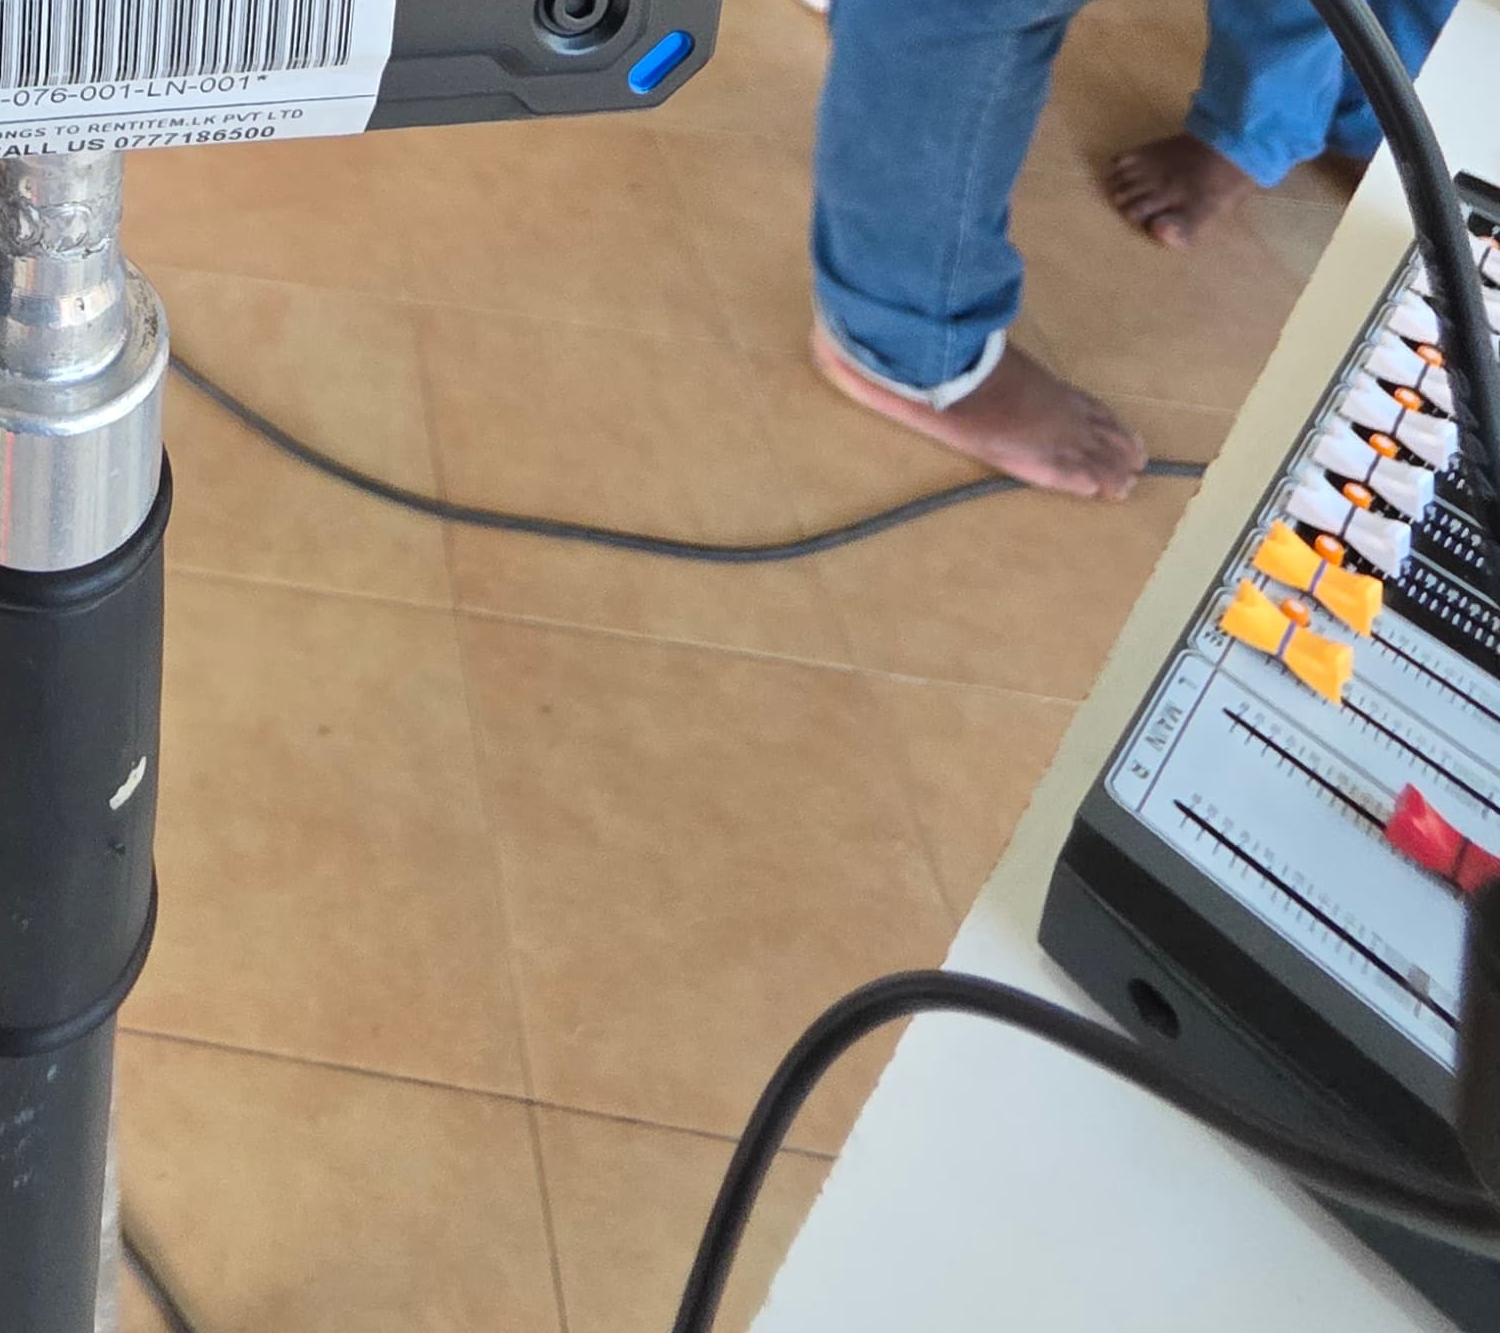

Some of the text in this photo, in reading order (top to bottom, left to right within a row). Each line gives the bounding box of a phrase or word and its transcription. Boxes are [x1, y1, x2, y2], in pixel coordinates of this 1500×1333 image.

[57, 124, 80, 135] TO
[88, 115, 216, 133] RENTITEM.LK
[223, 111, 261, 123] PVT
[268, 108, 304, 121] LTD
[68, 138, 105, 152] US
[114, 126, 275, 149] 0777186500
